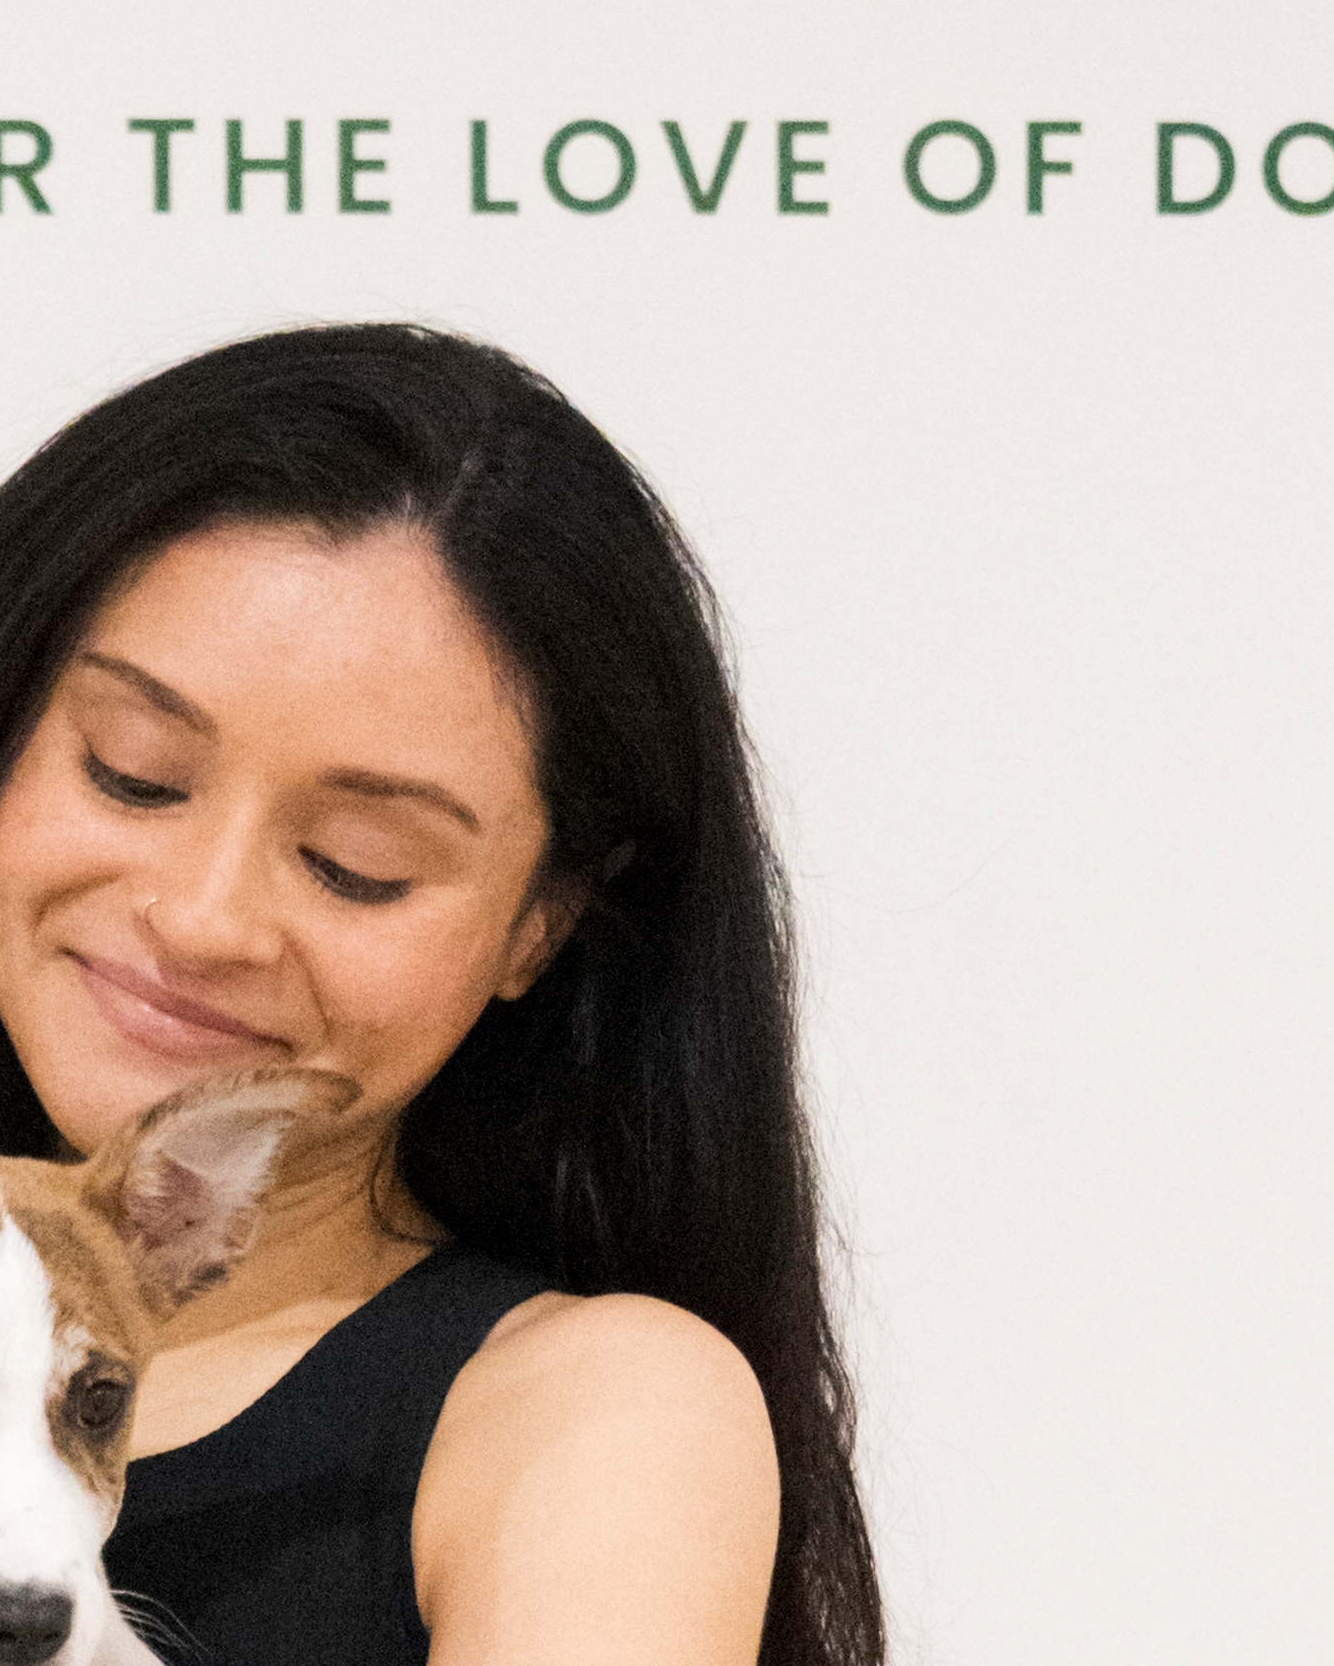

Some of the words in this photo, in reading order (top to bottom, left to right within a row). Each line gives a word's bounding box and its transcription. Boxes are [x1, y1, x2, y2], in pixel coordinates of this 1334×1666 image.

[126, 117, 392, 216] THE
[469, 117, 831, 217] LOVE
[901, 118, 1084, 217] OF
